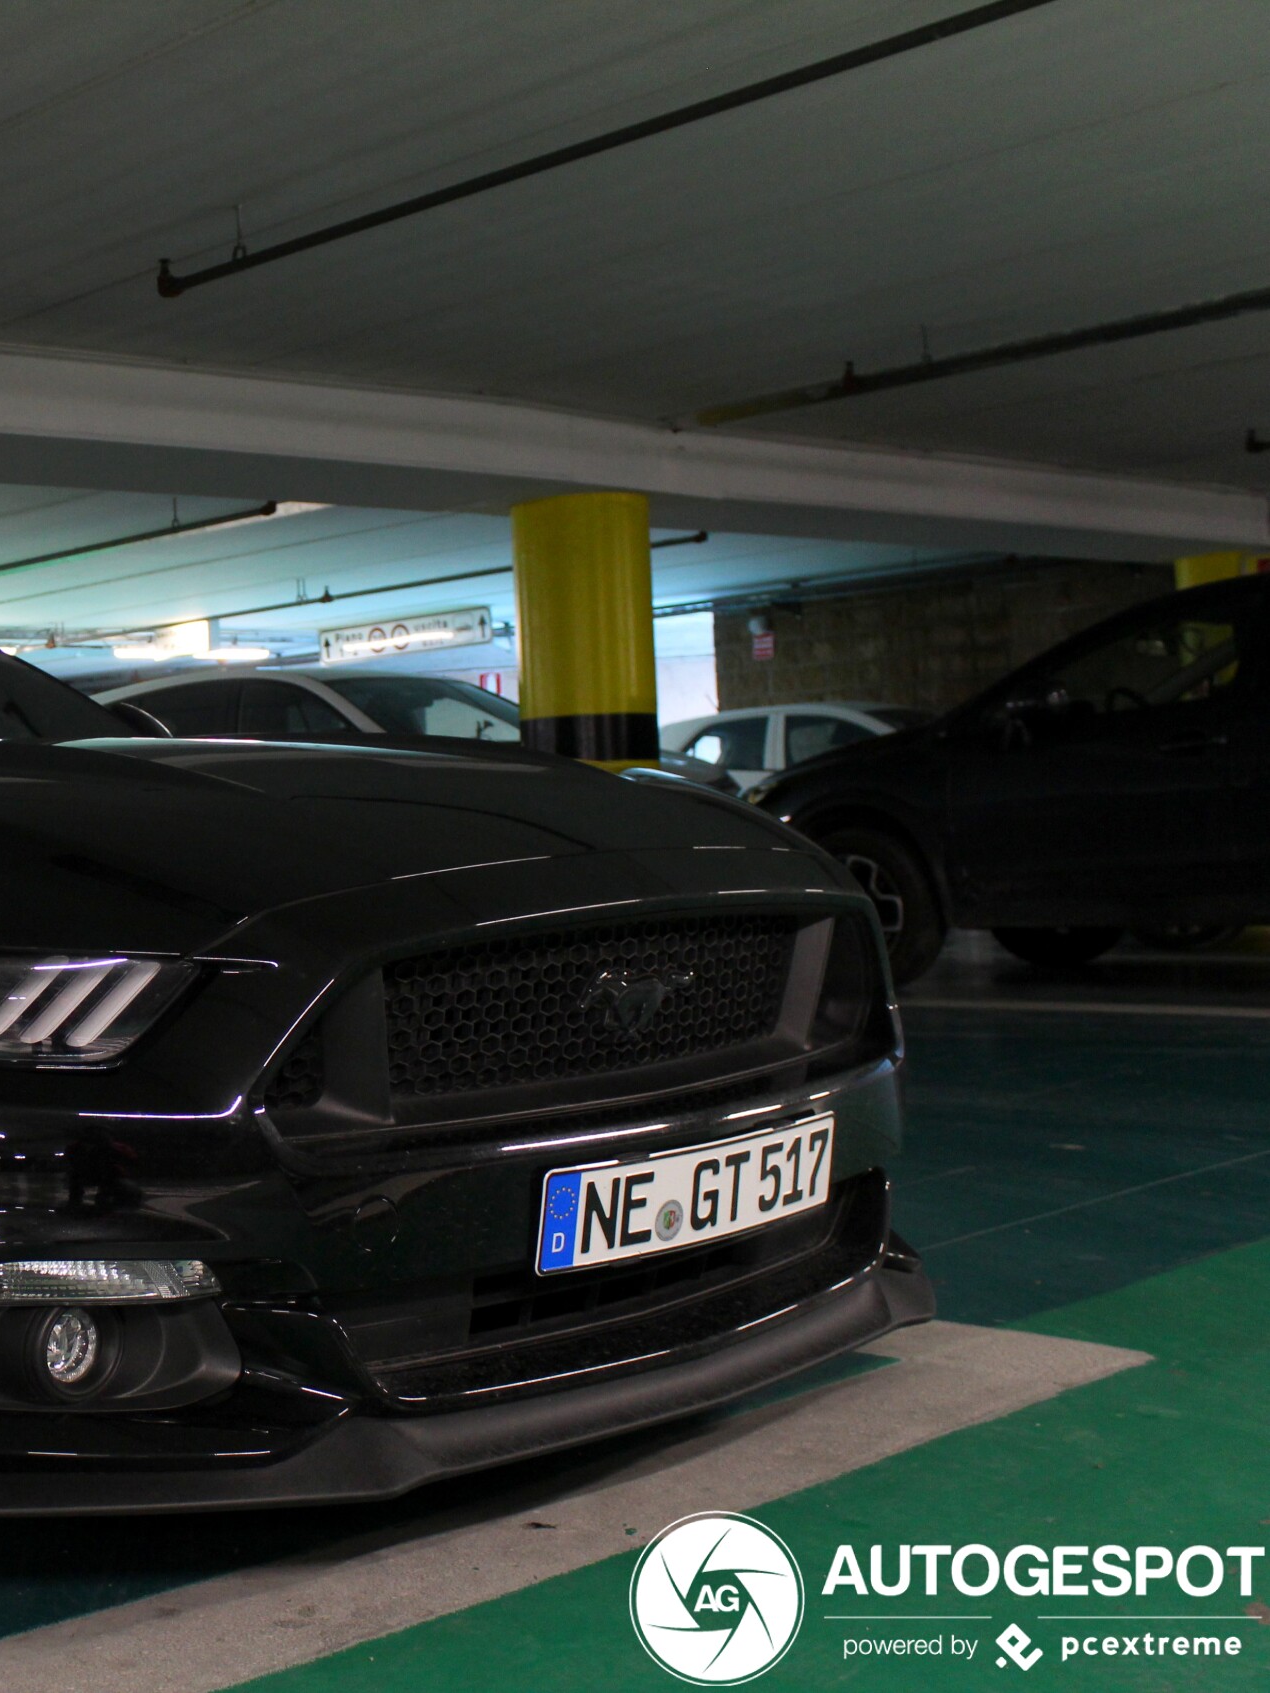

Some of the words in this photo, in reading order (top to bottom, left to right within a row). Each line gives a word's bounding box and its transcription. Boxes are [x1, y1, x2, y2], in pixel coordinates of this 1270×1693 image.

[581, 1172, 654, 1254] NE
[691, 1151, 750, 1230] GT
[759, 1129, 829, 1211] 517
[551, 1232, 566, 1254] D
